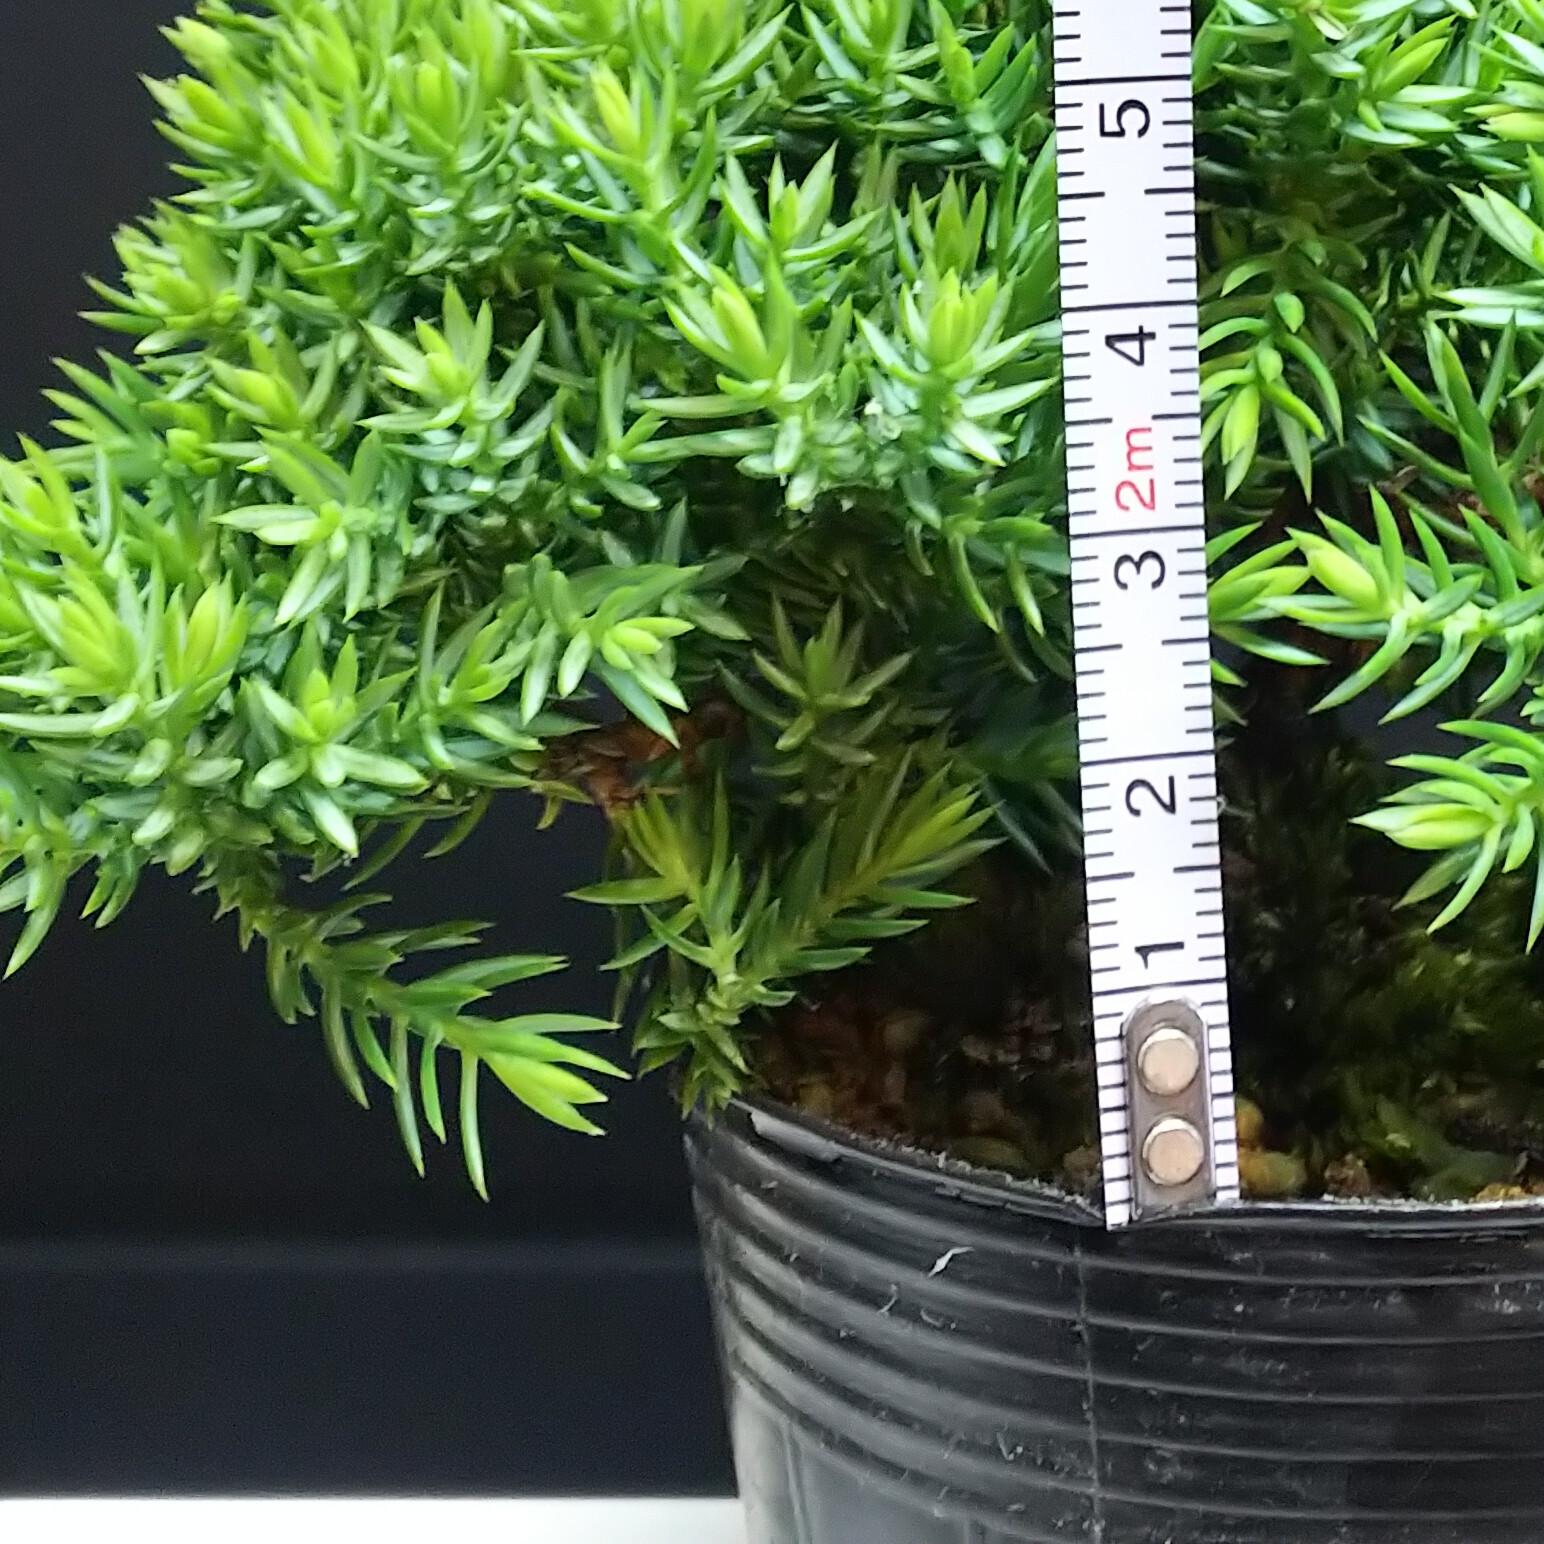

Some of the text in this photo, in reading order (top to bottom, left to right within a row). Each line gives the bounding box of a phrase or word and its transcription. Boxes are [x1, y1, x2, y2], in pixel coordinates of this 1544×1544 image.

[1099, 99, 1151, 139] 5
[1105, 324, 1156, 365] 4
[1115, 426, 1158, 512] 2m
[1113, 550, 1166, 589] 3
[1125, 775, 1177, 816] 2
[1135, 942, 1184, 969] 1
